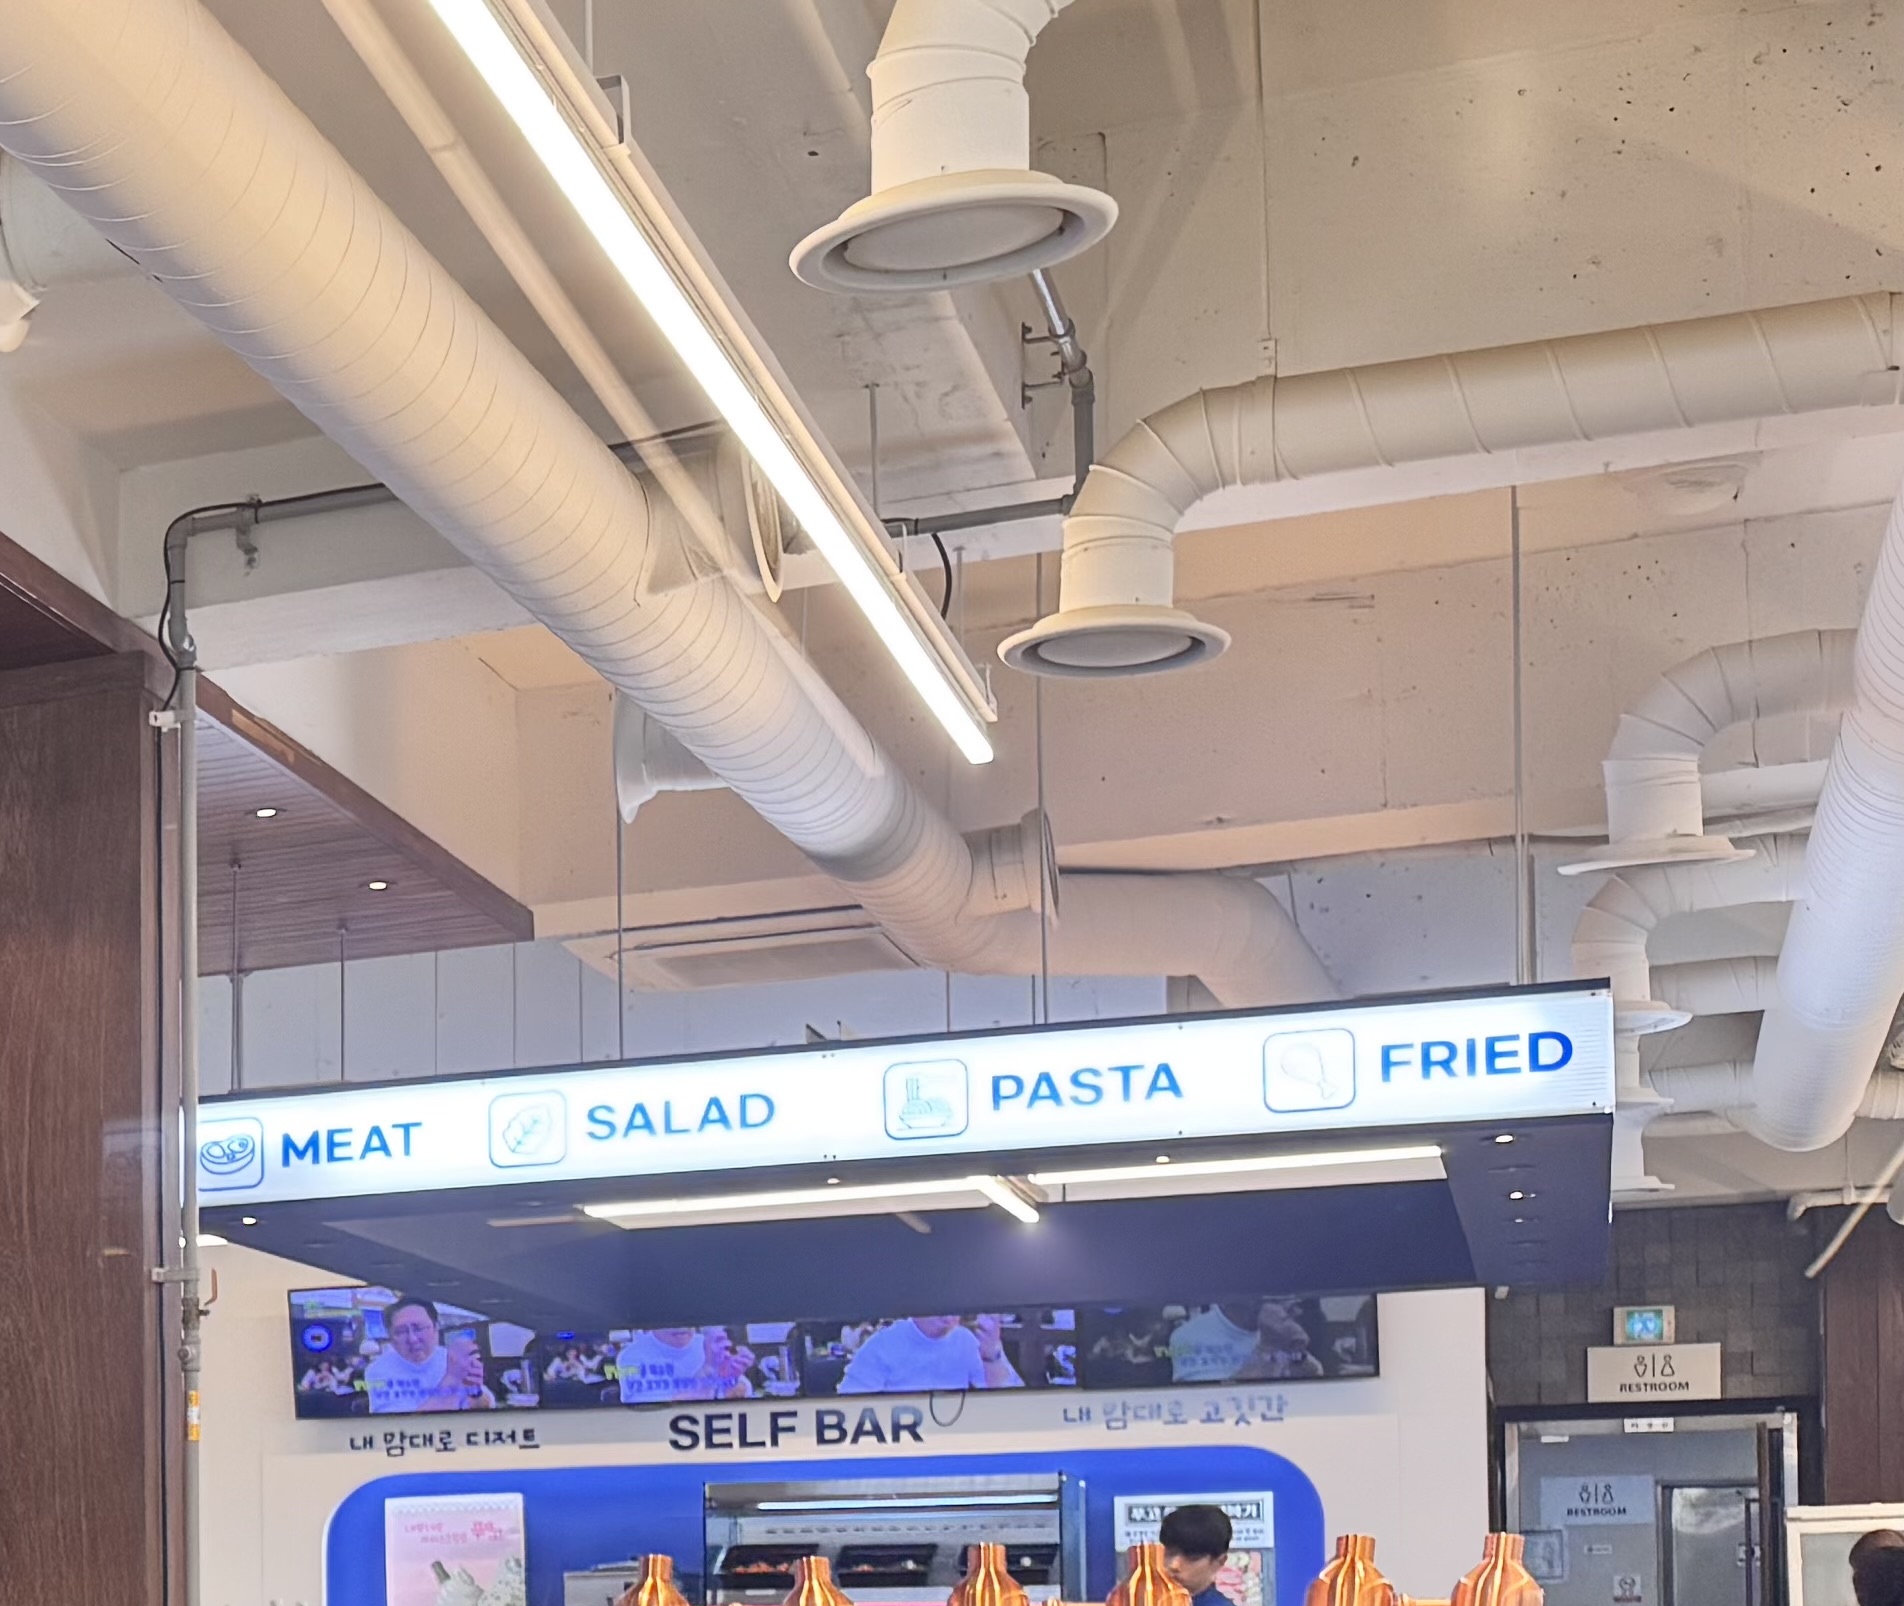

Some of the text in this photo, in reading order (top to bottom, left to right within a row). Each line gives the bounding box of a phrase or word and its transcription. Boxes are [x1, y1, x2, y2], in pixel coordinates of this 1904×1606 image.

[1380, 1030, 1574, 1084] FRIED
[991, 1062, 1184, 1112] PASTA
[586, 1092, 776, 1142] SALAD
[280, 1121, 423, 1168] MEAT
[1618, 1381, 1691, 1393] RESTROOM
[349, 1434, 374, 1452] 내
[465, 1427, 542, 1450] 디저트
[668, 1405, 925, 1452] SELF BAR
